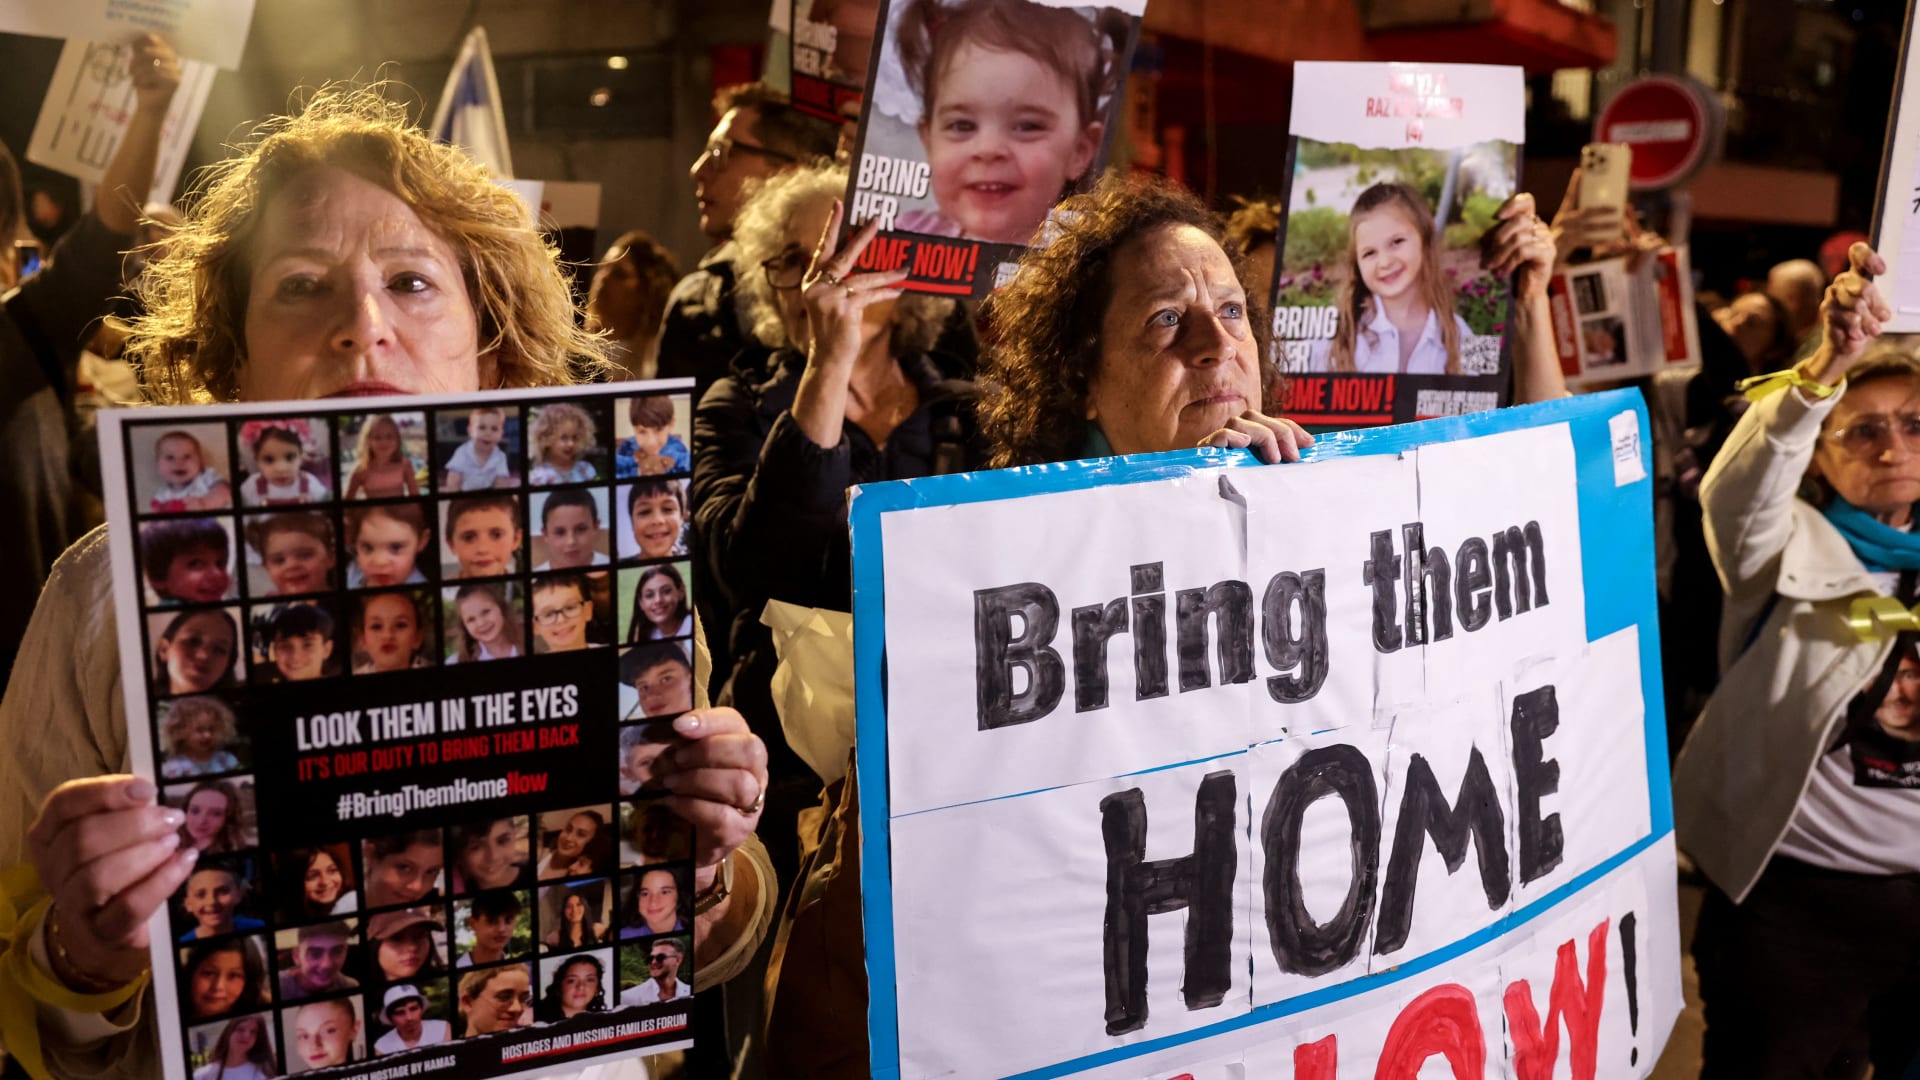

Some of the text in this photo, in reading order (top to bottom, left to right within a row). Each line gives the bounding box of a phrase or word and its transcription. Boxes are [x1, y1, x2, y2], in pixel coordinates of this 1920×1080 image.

[856, 153, 931, 198] BRING
[849, 233, 912, 272] OME
[912, 242, 980, 282] NOW!
[1272, 306, 1338, 339] BRING
[1277, 374, 1394, 411] OME NOW!
[974, 520, 1550, 731] Bring them
[296, 684, 579, 751] LOOK THEM IN THE EYES
[298, 723, 580, 781] IT'S OUR DUTY TO BRING THEM BACK
[337, 771, 549, 821] #BringThemHomeNow
[1100, 684, 1565, 1035] HOME
[502, 1013, 687, 1060] HOSTAGES AND MISSING FAMILIES FORUM
[410, 1062, 423, 1074] BY
[424, 1055, 456, 1072] HAMAS
